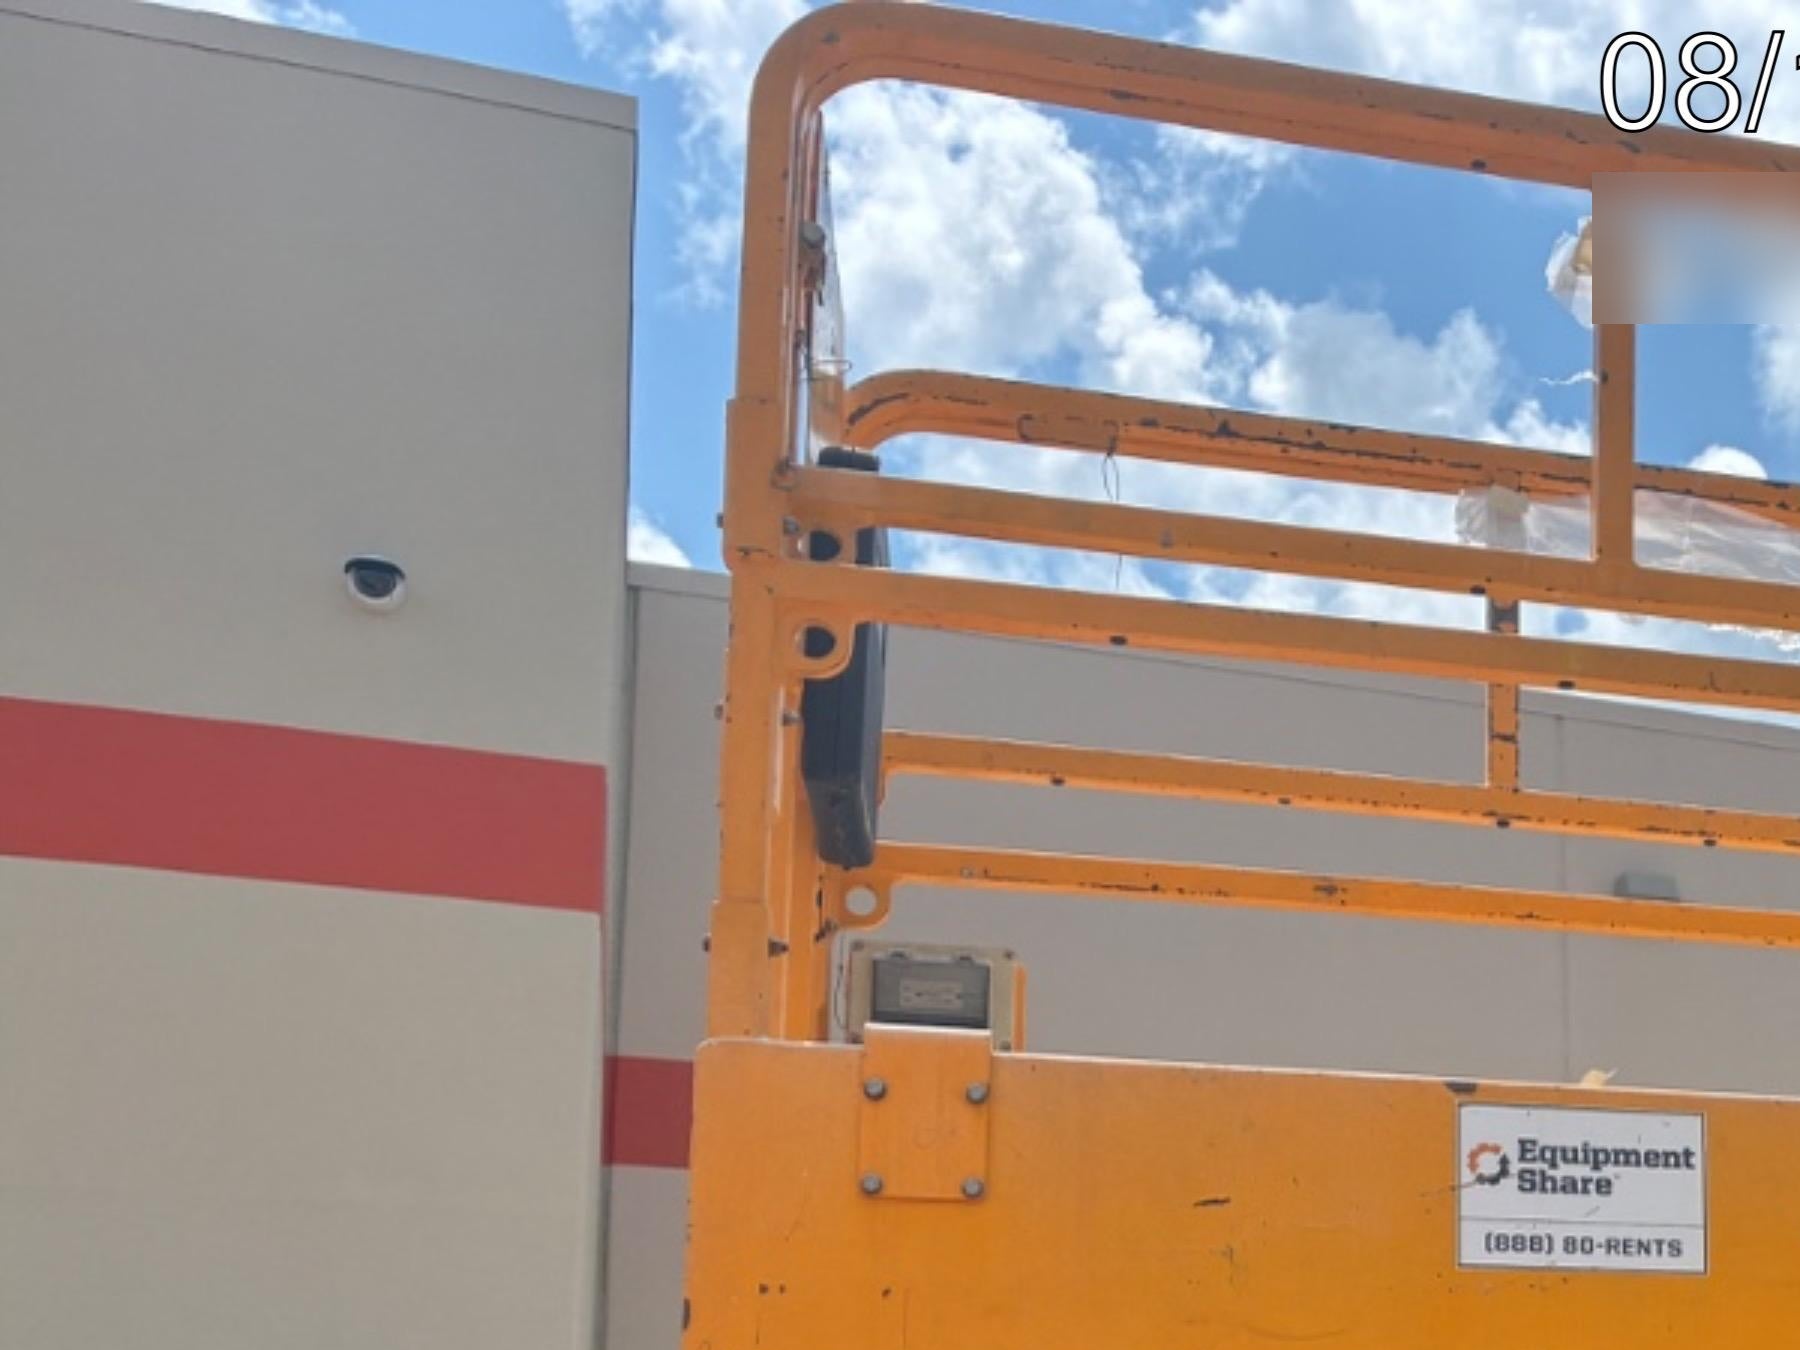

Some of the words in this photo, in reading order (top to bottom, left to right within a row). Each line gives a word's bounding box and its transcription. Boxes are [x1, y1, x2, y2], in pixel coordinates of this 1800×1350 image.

[1517, 1138, 1696, 1171] Equipment
[1517, 1168, 1613, 1195] Share
[1484, 1232, 1555, 1255] (888)
[1563, 1235, 1683, 1257] 80-RENTS
